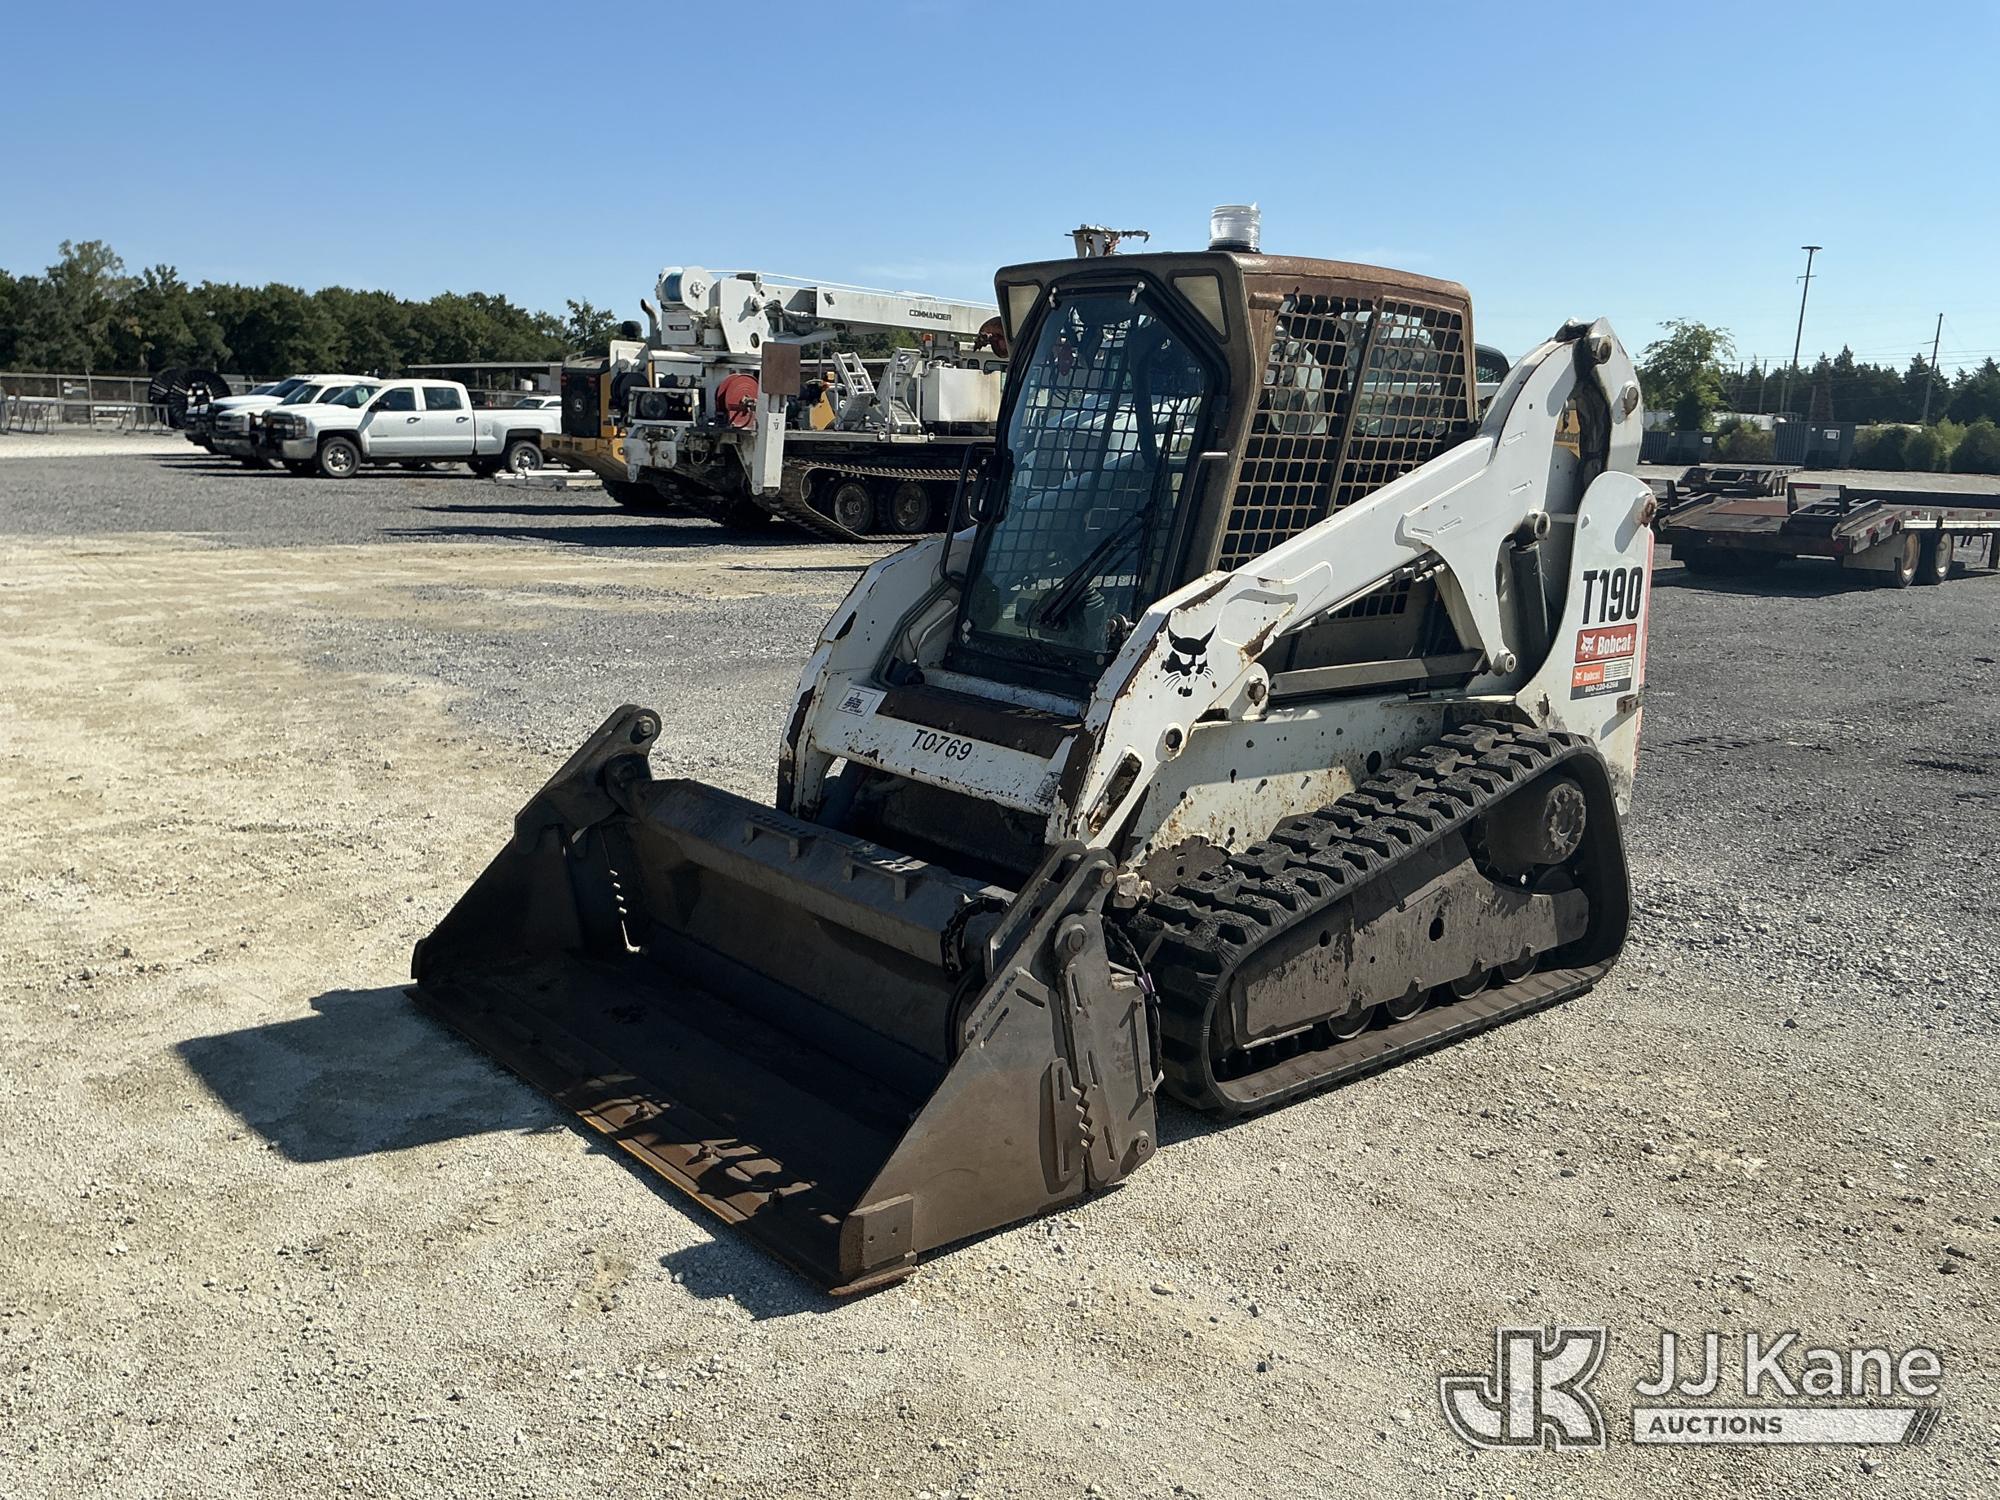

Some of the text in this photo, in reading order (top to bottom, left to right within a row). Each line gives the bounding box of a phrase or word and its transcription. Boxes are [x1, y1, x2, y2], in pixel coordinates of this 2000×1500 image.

[909, 309, 952, 321] COMMANDER
[1582, 566, 1643, 625] T190
[1597, 633, 1632, 656] Bobcat
[911, 729, 973, 761] T0769
